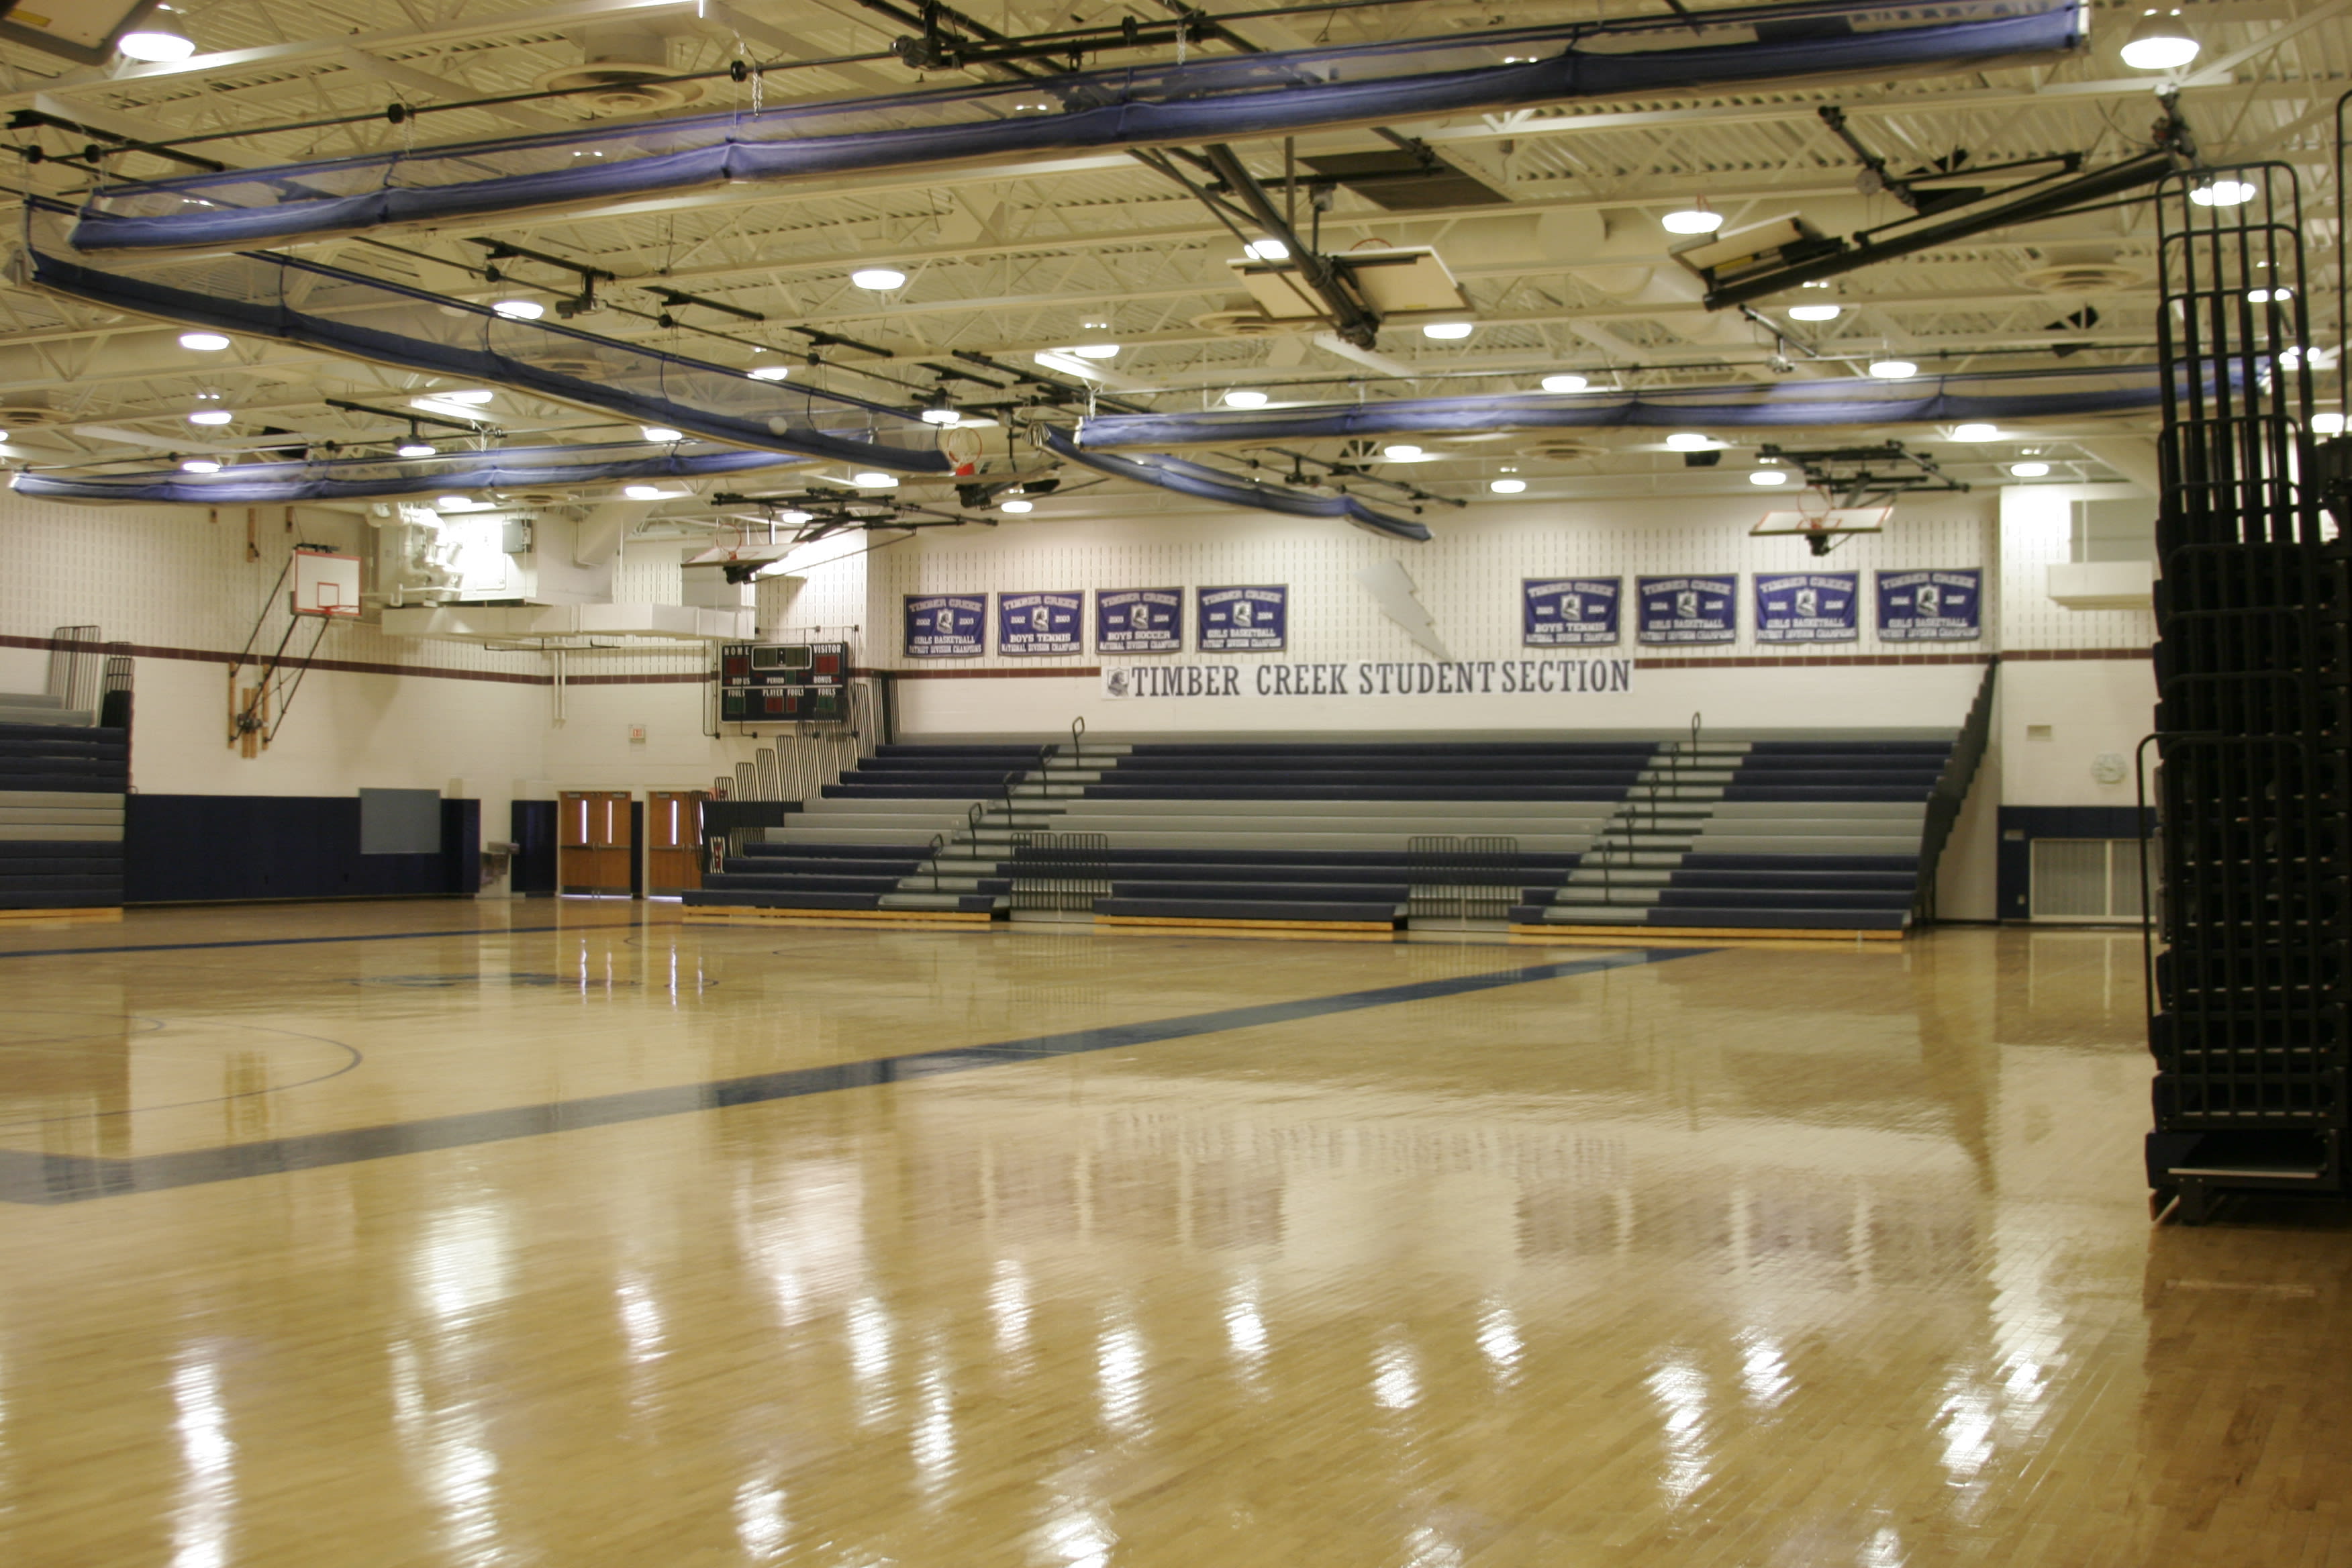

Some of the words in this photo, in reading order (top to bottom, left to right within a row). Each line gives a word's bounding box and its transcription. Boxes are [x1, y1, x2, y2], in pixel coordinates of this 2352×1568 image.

[1759, 577, 1807, 593] TIMBER
[1810, 577, 1853, 592] CREEK
[1881, 573, 1929, 589] TIMBER
[1932, 573, 1976, 589] CREEK
[1528, 582, 1572, 597] TIMBER
[1575, 582, 1614, 597] CREEK
[1643, 579, 1688, 595] TIMBER
[1691, 579, 1731, 595] CREEK
[1003, 595, 1042, 610] TIMBER
[1044, 595, 1079, 609] CREEK
[1101, 593, 1140, 607] TIMBER
[1143, 592, 1177, 606] CREEK
[1202, 590, 1242, 605] TIMBER
[1245, 590, 1282, 603] CREEK
[909, 598, 946, 612] TIMBER
[949, 598, 982, 612] CREEK
[1055, 615, 1071, 623] 2003
[1767, 619, 1791, 628] GIRLS
[1792, 618, 1845, 628] BASKETBALL
[1888, 618, 1912, 628] GIRLS
[1914, 618, 1968, 627] BASKETBALL
[1534, 623, 1563, 632] BOYS
[1566, 622, 1606, 632] TENNIS
[1649, 620, 1671, 630] GIRLS
[1673, 619, 1724, 629] BASKETBALL
[1010, 634, 1034, 643] BOYS
[1036, 633, 1071, 642] TENNIS
[1108, 632, 1132, 640] BOYS
[1134, 631, 1171, 640] SOCCER
[1207, 629, 1228, 638] GIRLS
[1230, 628, 1276, 638] BASKETBALL
[914, 636, 932, 644] GIRLS
[934, 635, 975, 644] BASKETBALL
[724, 646, 750, 656] HOME
[813, 644, 842, 654] VISITOR
[909, 646, 929, 654] PATRIOT
[930, 645, 952, 653] DIVISION
[953, 644, 981, 653] CHAMPIONS
[1001, 644, 1026, 652] NATIONAL
[1028, 643, 1050, 652] DIVISION
[1051, 642, 1079, 652] CHAMPIONS
[813, 675, 832, 684] BONUS
[1131, 665, 1240, 697] TIMBER
[1257, 664, 1348, 695] CREEK
[1359, 661, 1496, 695] STUDENT
[1502, 659, 1631, 693] SECTION
[728, 689, 746, 697] FOULS
[763, 689, 783, 697] PLAYER
[787, 688, 804, 696] FOULS
[818, 687, 836, 697] FOULS
